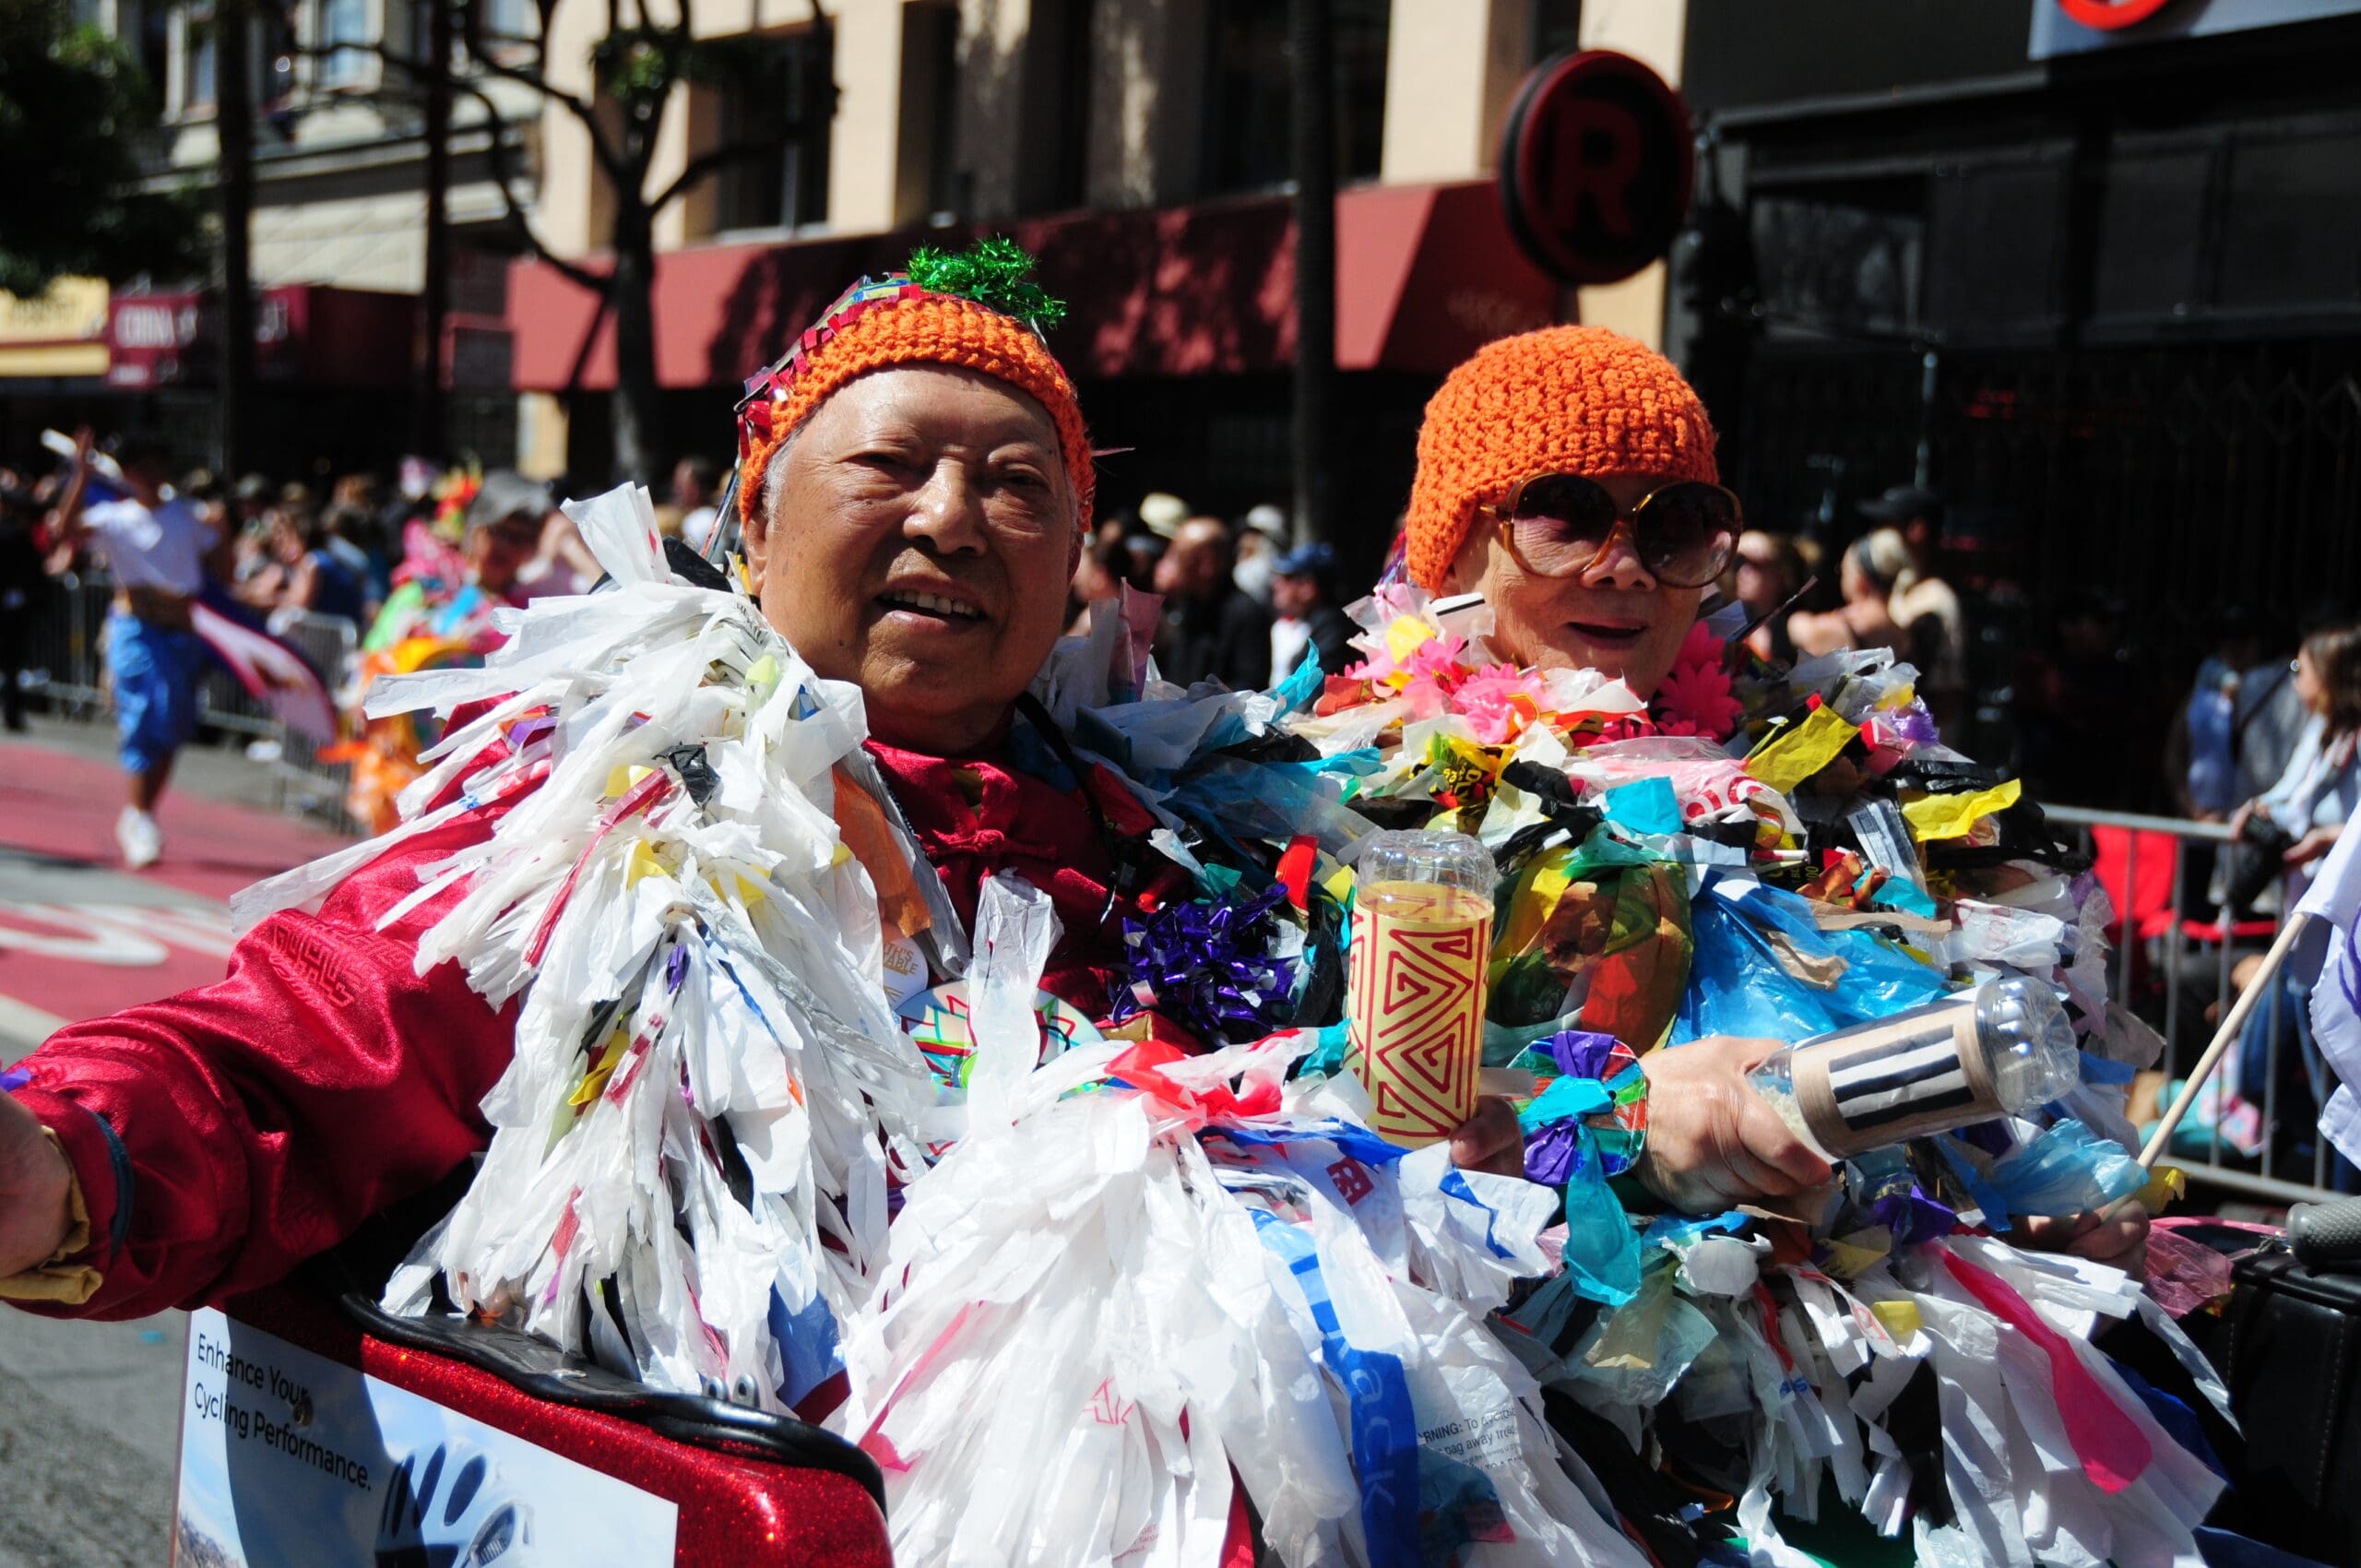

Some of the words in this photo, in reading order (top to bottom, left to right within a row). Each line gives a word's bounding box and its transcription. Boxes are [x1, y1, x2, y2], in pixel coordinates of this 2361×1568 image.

[1550, 99, 1641, 234] R
[197, 1333, 265, 1390] Enhance
[195, 1382, 250, 1440] Cycling
[254, 1410, 373, 1491] Performance.
[1465, 1418, 1478, 1431] To
[1466, 1432, 1493, 1449] away
